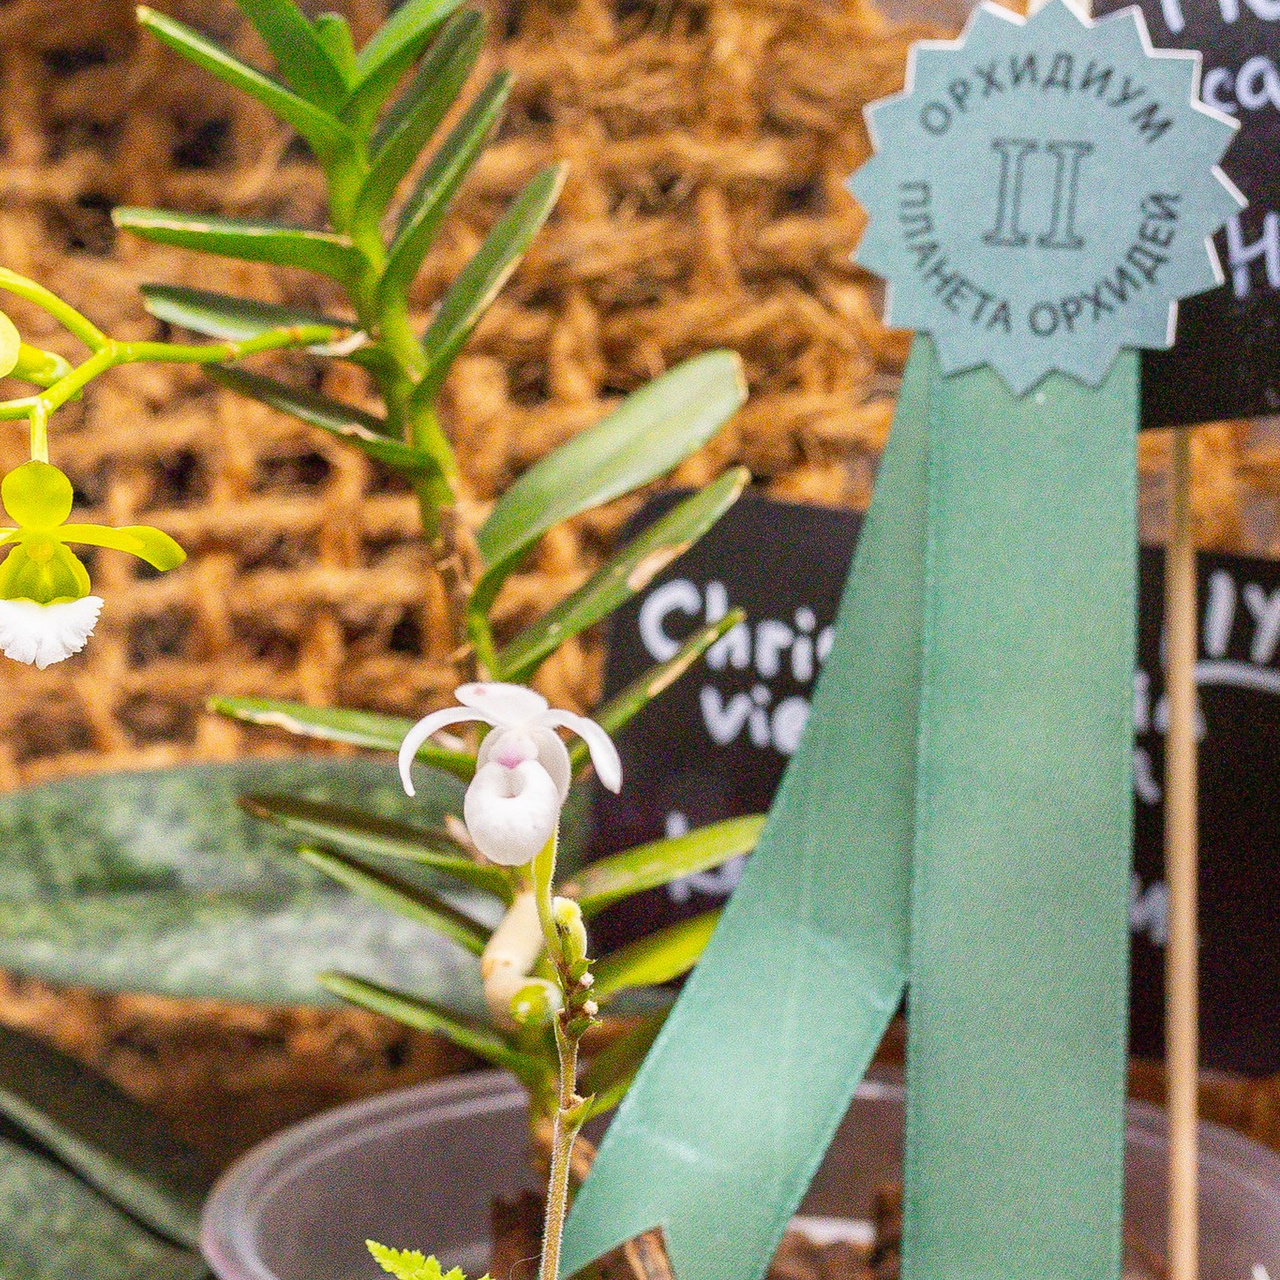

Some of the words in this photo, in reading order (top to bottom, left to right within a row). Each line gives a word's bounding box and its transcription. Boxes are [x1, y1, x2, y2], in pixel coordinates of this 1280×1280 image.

[920, 47, 1173, 143] ОРХИДИУМ
[899, 179, 1013, 332] ПЛАНЕТА
[1028, 188, 1182, 338] ОРХИДЕЙ
